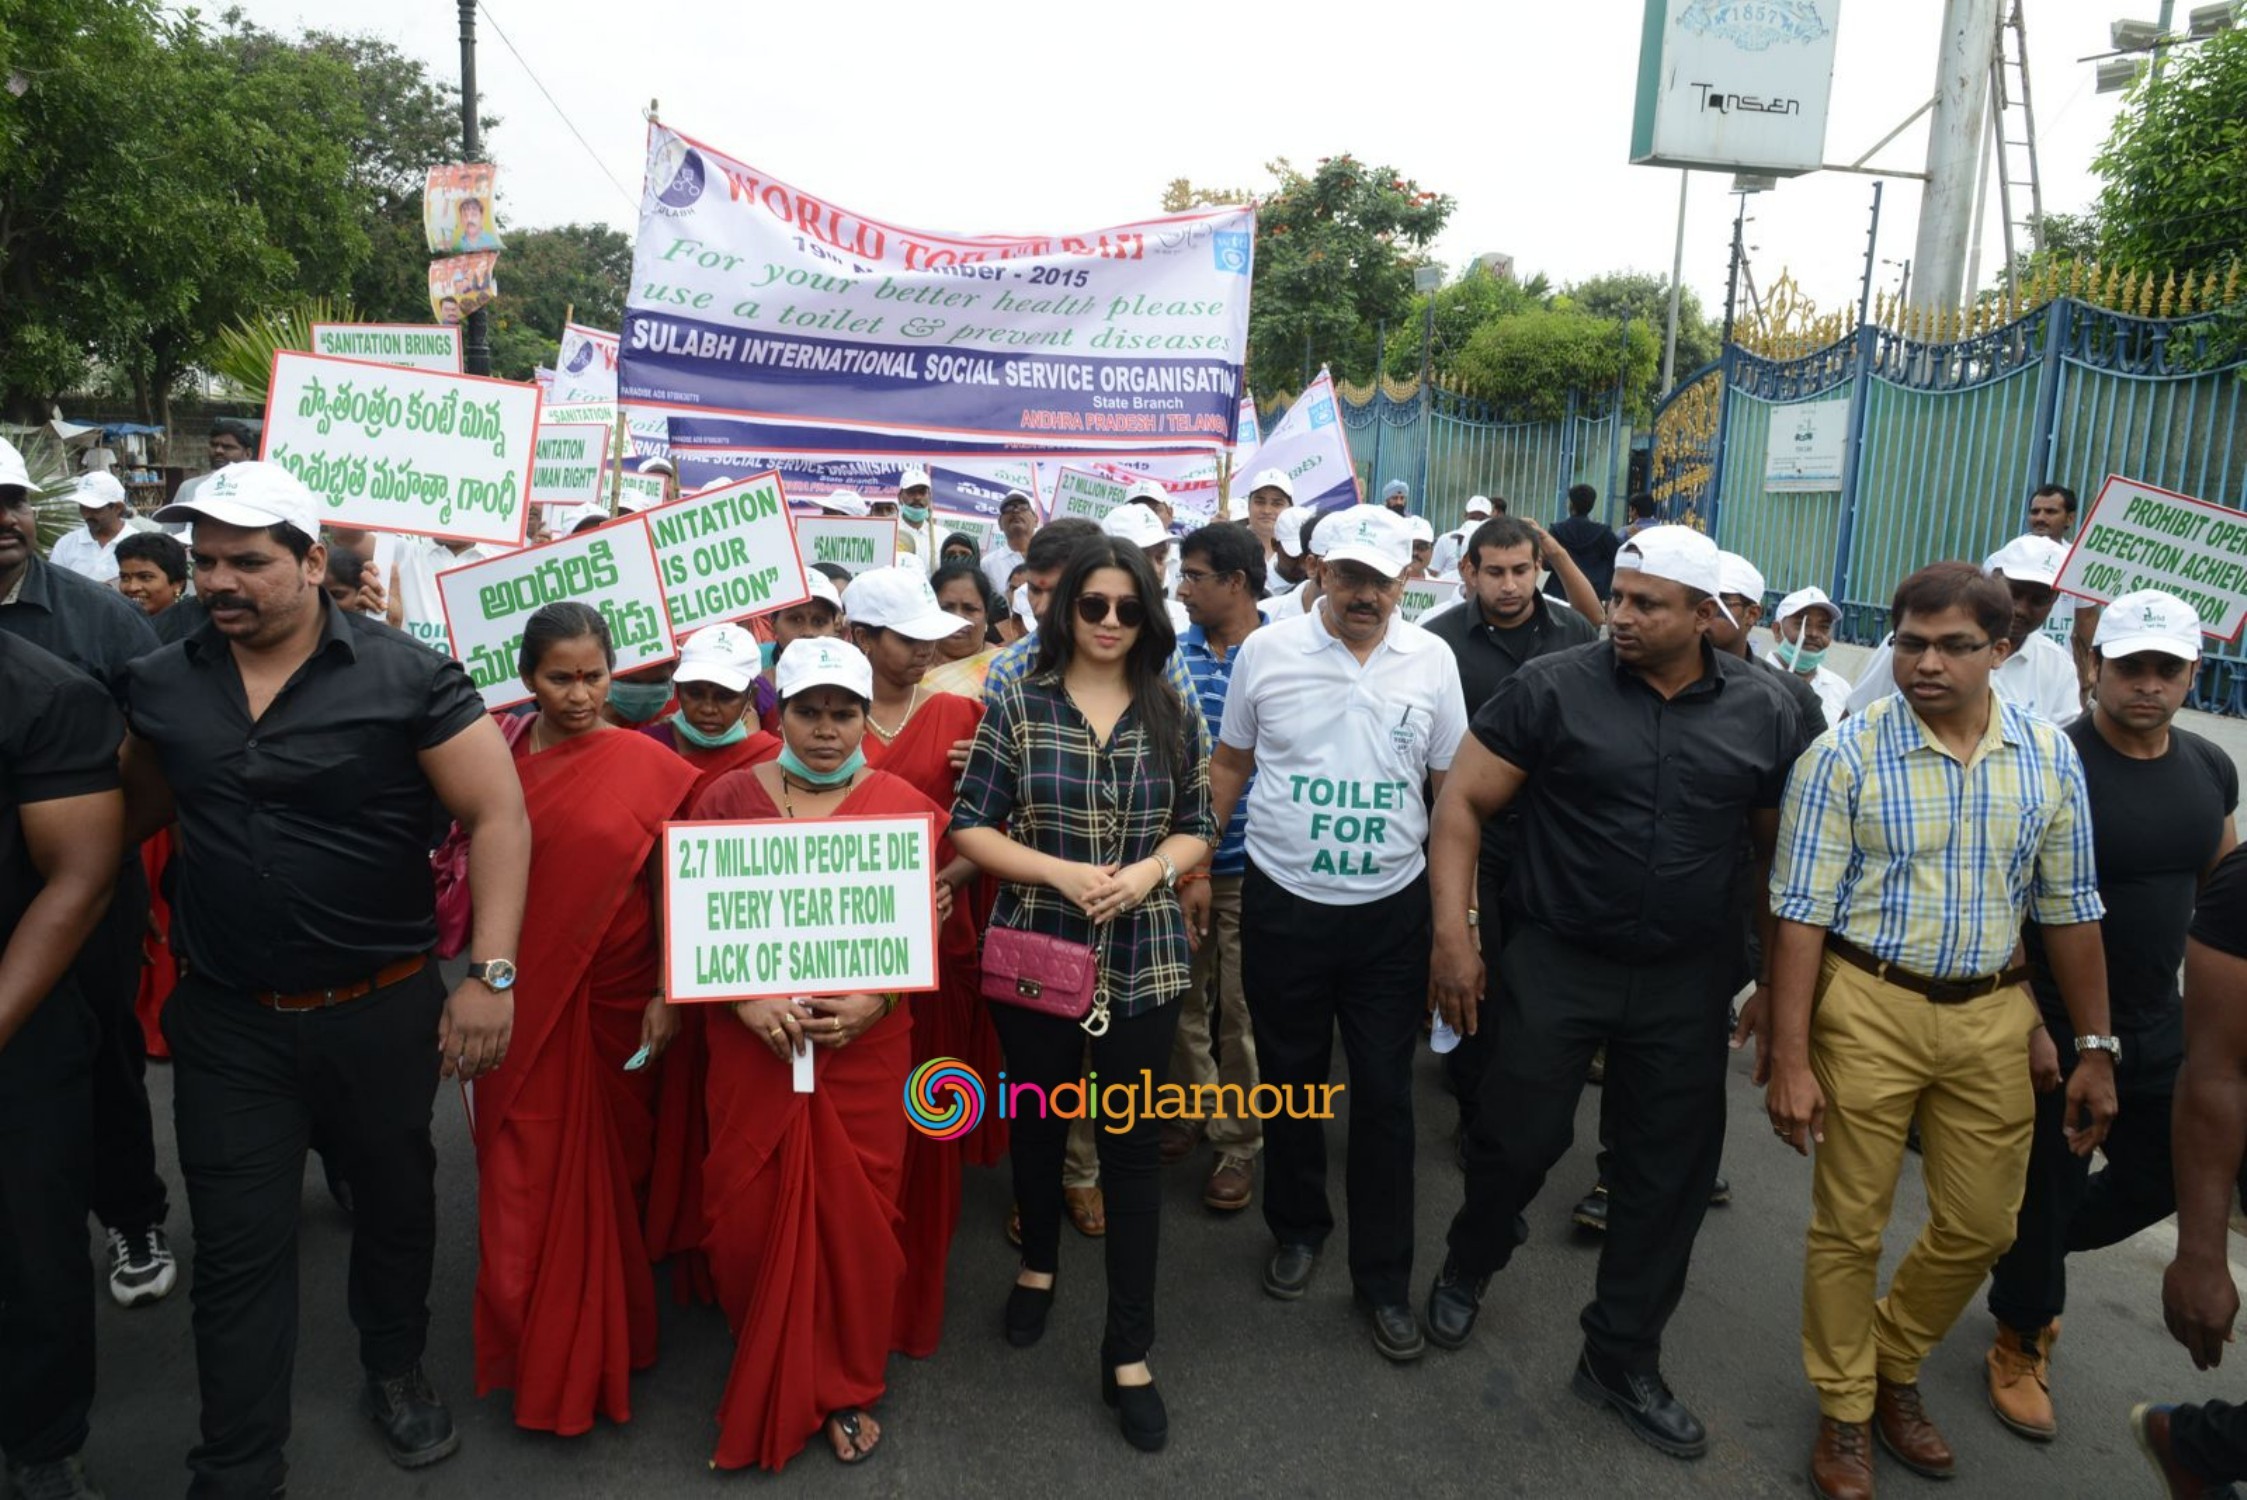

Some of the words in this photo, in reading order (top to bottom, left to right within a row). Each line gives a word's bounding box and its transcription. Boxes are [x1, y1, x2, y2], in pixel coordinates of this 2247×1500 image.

[722, 166, 885, 261] WORLD
[658, 238, 744, 272] For
[750, 262, 859, 297] your
[874, 275, 980, 312] better
[992, 289, 1096, 316] health
[1105, 294, 1224, 321] please
[1028, 265, 1089, 287] 2015
[643, 283, 714, 309] use
[733, 299, 760, 321] a
[778, 308, 883, 335] toilet
[900, 316, 945, 338] &
[948, 322, 1073, 351] prevent
[405, 334, 452, 356] BRINGS
[632, 318, 734, 362] SULABH
[740, 337, 919, 380] INTERNATIONAL
[923, 353, 1000, 386] SOCIAL
[1004, 361, 1095, 391] SERVICE
[1020, 409, 1084, 431] ANDHRA
[1085, 413, 1156, 433] PRADESH
[1093, 396, 1129, 410] State
[1133, 396, 1184, 410] Branch
[533, 467, 561, 488] UMAN
[646, 482, 660, 497] DIE
[1075, 475, 1106, 503] MILLION
[1066, 496, 1092, 516] EVERY
[2123, 496, 2210, 541] PROHIBIT
[661, 554, 688, 588] IS
[693, 536, 750, 577] OUR
[814, 535, 875, 564] “SANITATION
[2084, 524, 2184, 574] DEFECTION
[2081, 561, 2127, 597] 100%
[1289, 774, 1409, 810] TOILET
[1310, 814, 1386, 844] FOR
[678, 839, 709, 879] 2.7
[715, 836, 798, 877] MILLION
[805, 833, 881, 873] PEOPLE
[887, 832, 920, 870] DIE
[1311, 849, 1380, 876] ALL
[707, 890, 773, 930] EVERY
[779, 887, 834, 927] YEAR
[840, 885, 896, 923] FROM
[696, 943, 750, 984] LACK
[756, 942, 782, 982] OF
[789, 937, 909, 980] SANITATION
